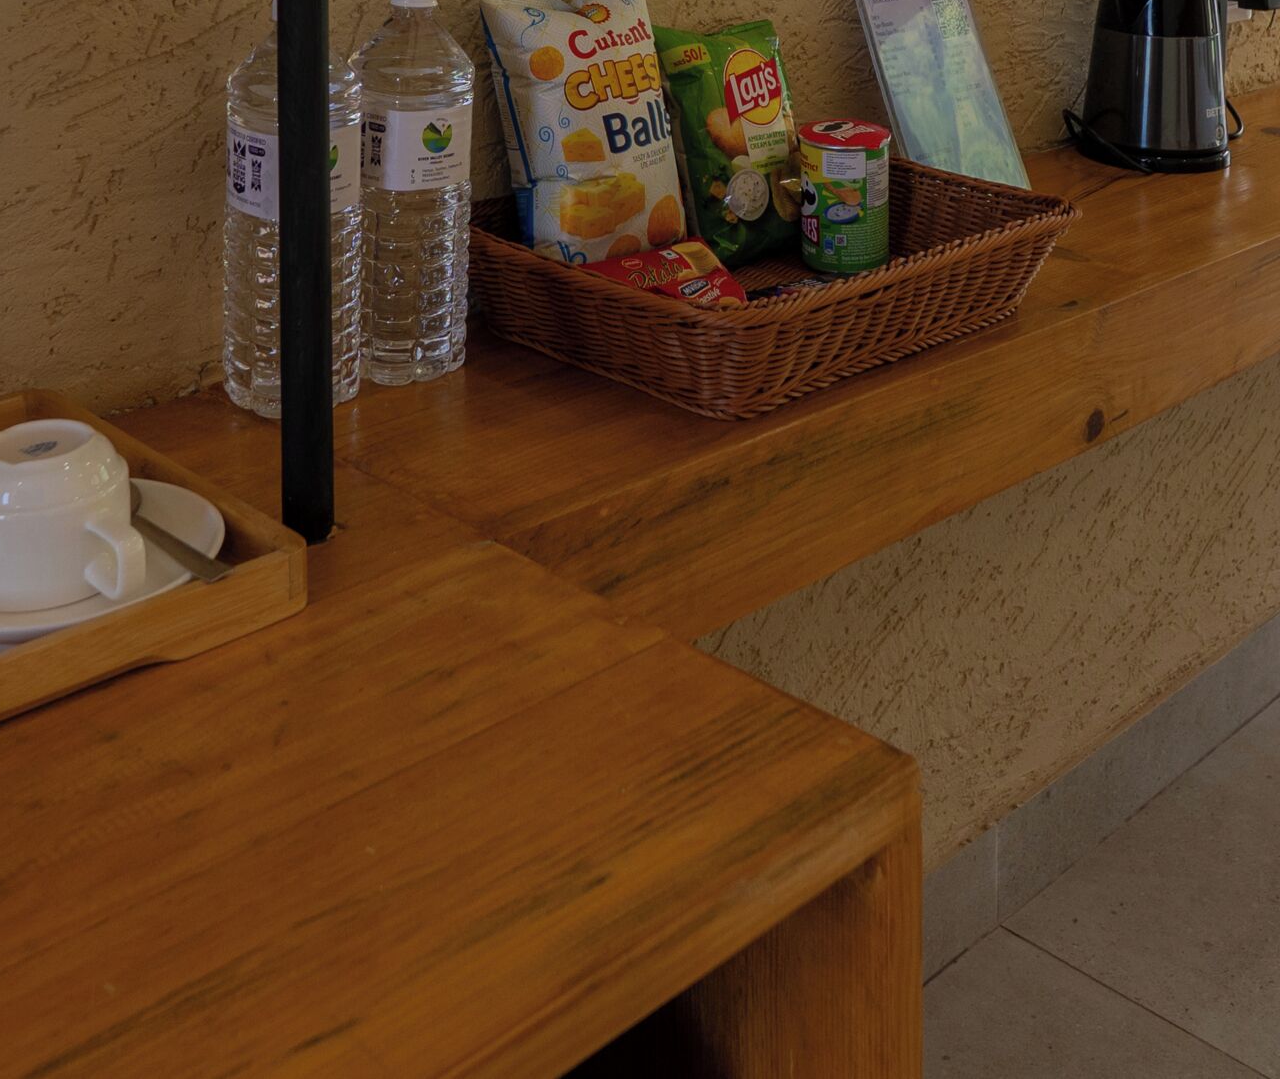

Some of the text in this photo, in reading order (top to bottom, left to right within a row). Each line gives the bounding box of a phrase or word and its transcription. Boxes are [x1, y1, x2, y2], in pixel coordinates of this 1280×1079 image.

[568, 18, 651, 59] Current
[564, 53, 661, 111] CHEES
[729, 62, 777, 115] Lay's
